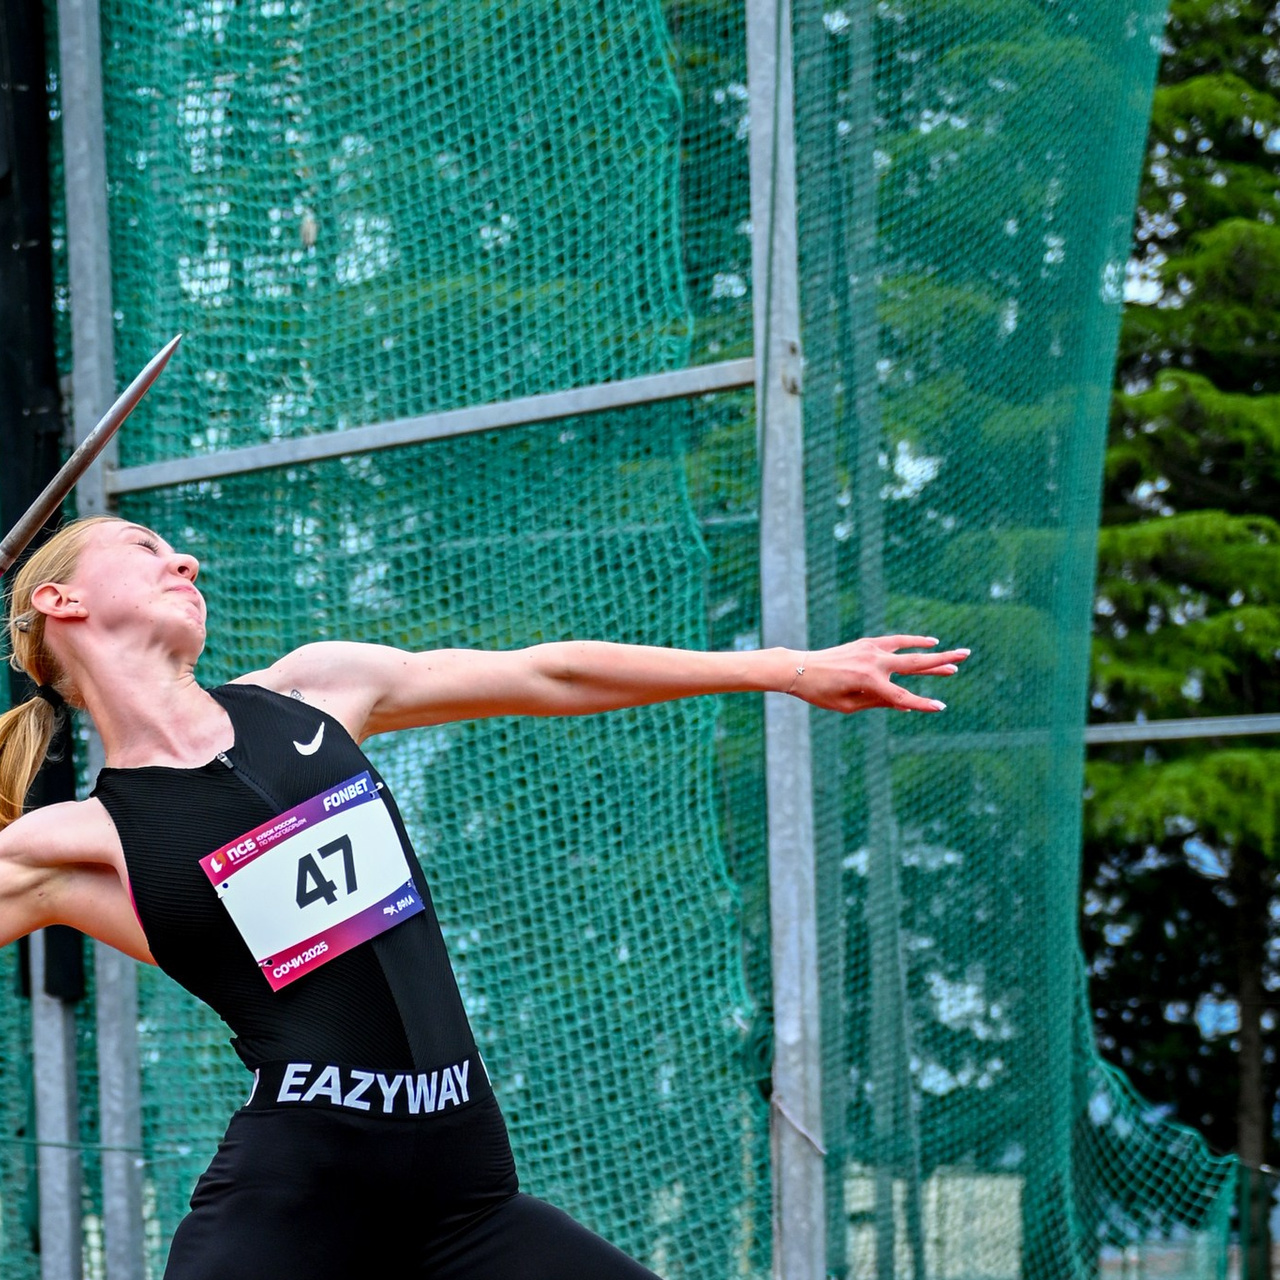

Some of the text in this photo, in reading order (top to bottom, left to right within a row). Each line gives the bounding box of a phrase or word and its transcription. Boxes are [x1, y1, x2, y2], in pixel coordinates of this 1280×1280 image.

[323, 778, 368, 811] FONBET
[274, 816, 297, 831] РОССИИ
[226, 838, 256, 862] ПСБ
[296, 834, 358, 909] 47
[273, 941, 329, 978] СОЧИ 2025
[277, 1060, 469, 1114] EAZYWAY
